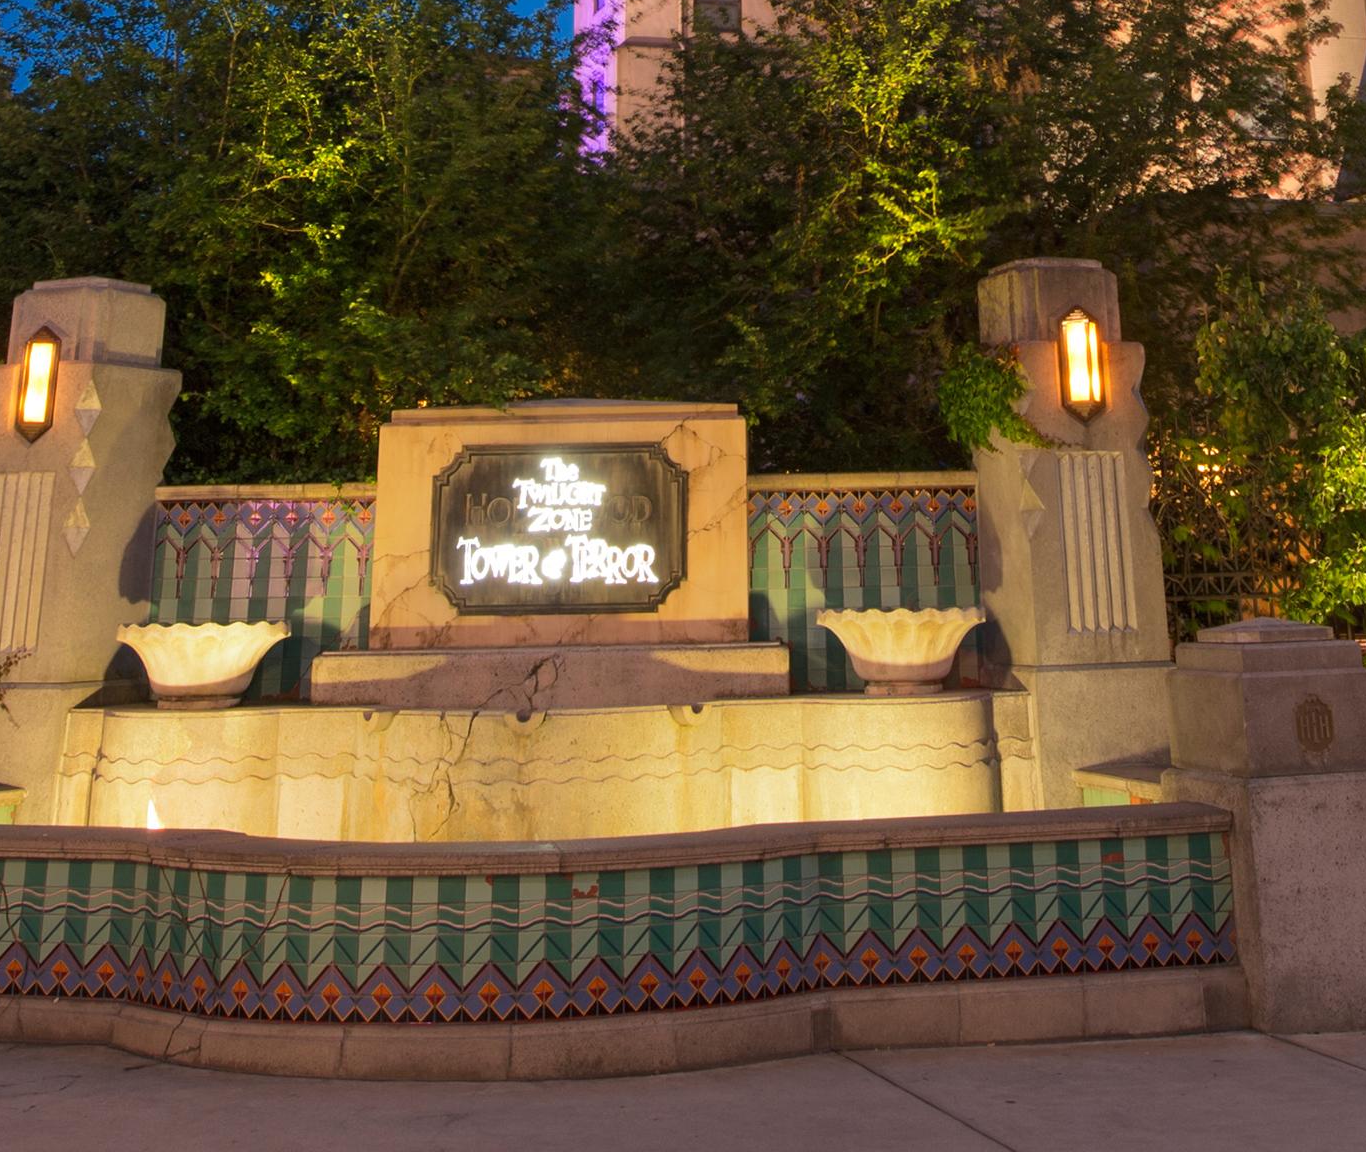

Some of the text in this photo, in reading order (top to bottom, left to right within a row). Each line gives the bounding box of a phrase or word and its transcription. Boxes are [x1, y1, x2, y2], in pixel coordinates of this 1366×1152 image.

[540, 457, 580, 482] The
[513, 478, 607, 510] TWILIGHT
[528, 508, 593, 533] ZONE
[456, 536, 543, 586] TOWER
[565, 534, 660, 585] TERROR
